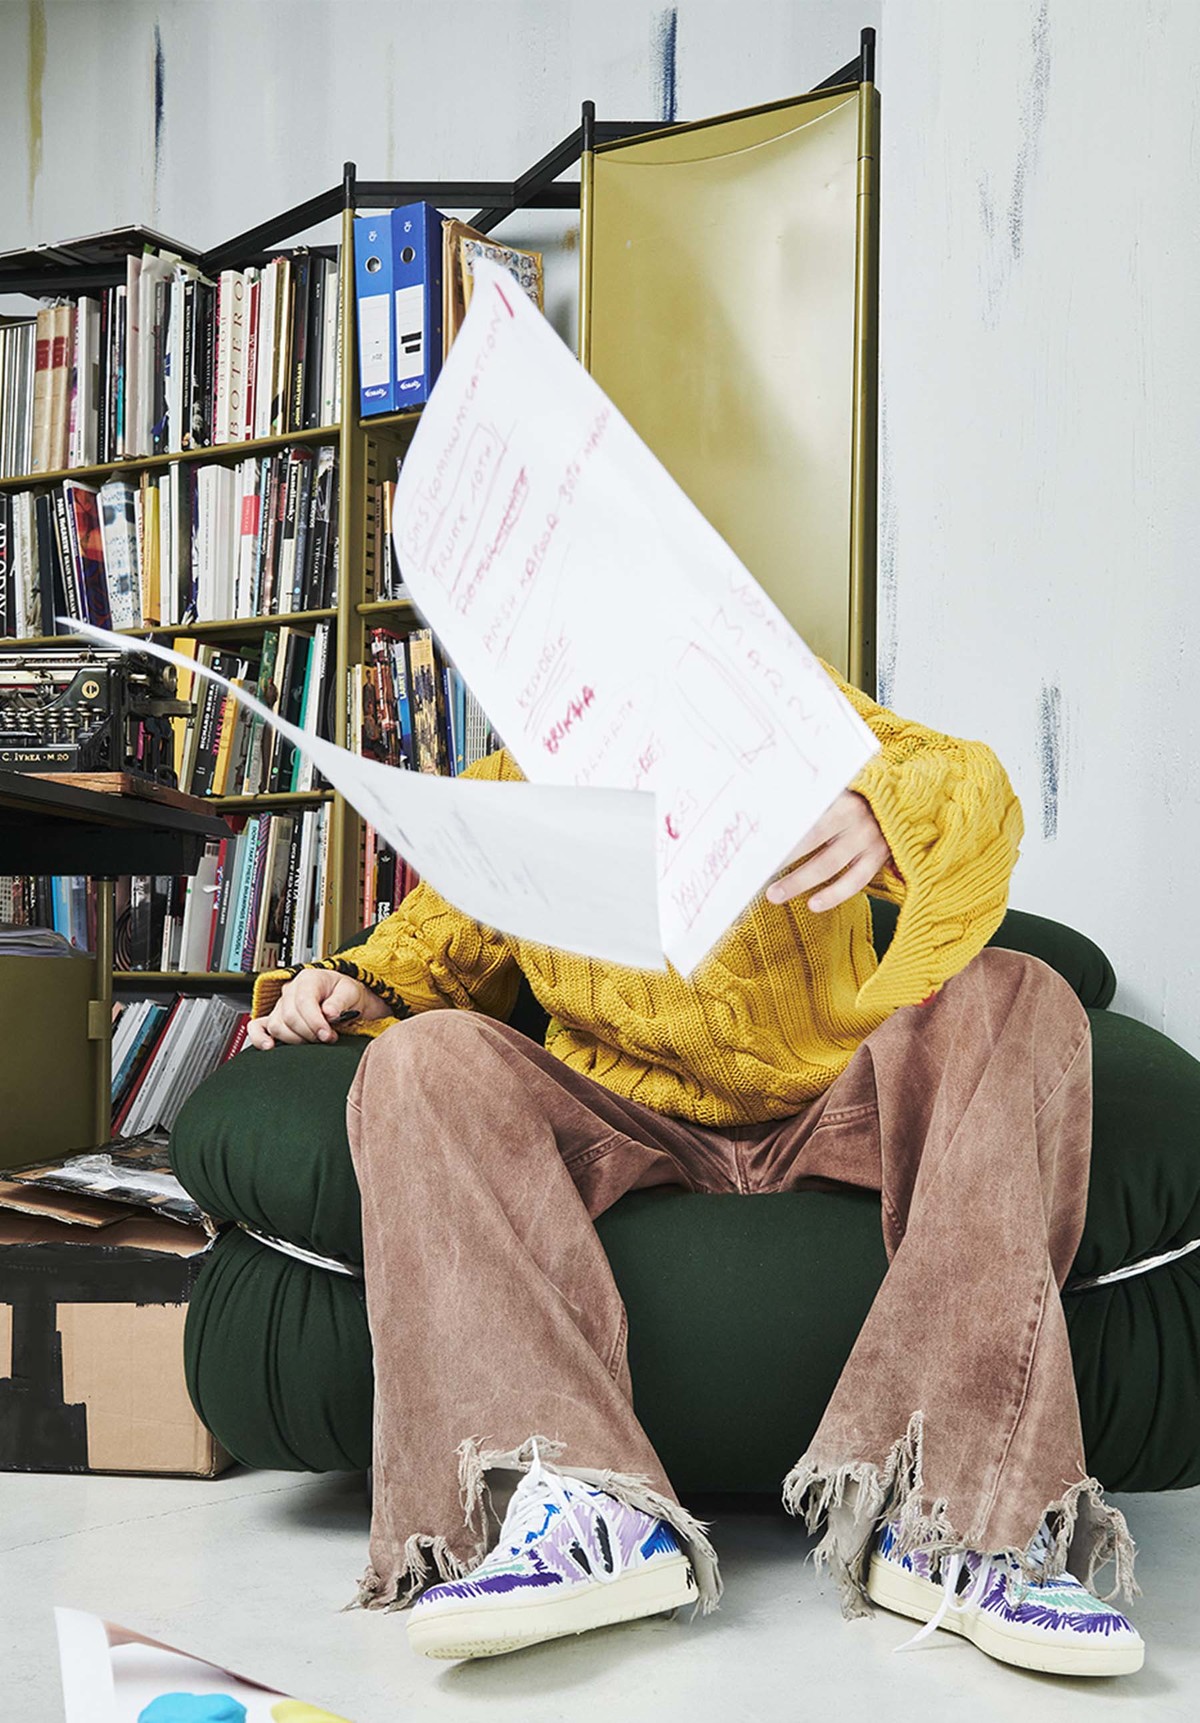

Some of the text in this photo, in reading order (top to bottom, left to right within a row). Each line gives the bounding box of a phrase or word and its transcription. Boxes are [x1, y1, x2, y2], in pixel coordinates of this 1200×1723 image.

[229, 280, 244, 437] BOTERO
[295, 362, 303, 406] BALDESSARI
[57, 498, 65, 518] PAUL
[287, 465, 299, 523] Kandinsky
[59, 518, 70, 555] McCARTHY
[395, 655, 407, 700] LARRY BELL
[199, 683, 216, 750] RICHARD SERRA
[14, 752, 41, 762] IVREA
[47, 753, 55, 761] M
[57, 753, 70, 761] 20
[250, 826, 258, 846] DON'T
[240, 886, 249, 920] DRAWINGS
[234, 921, 244, 956] SERIOUSLY
